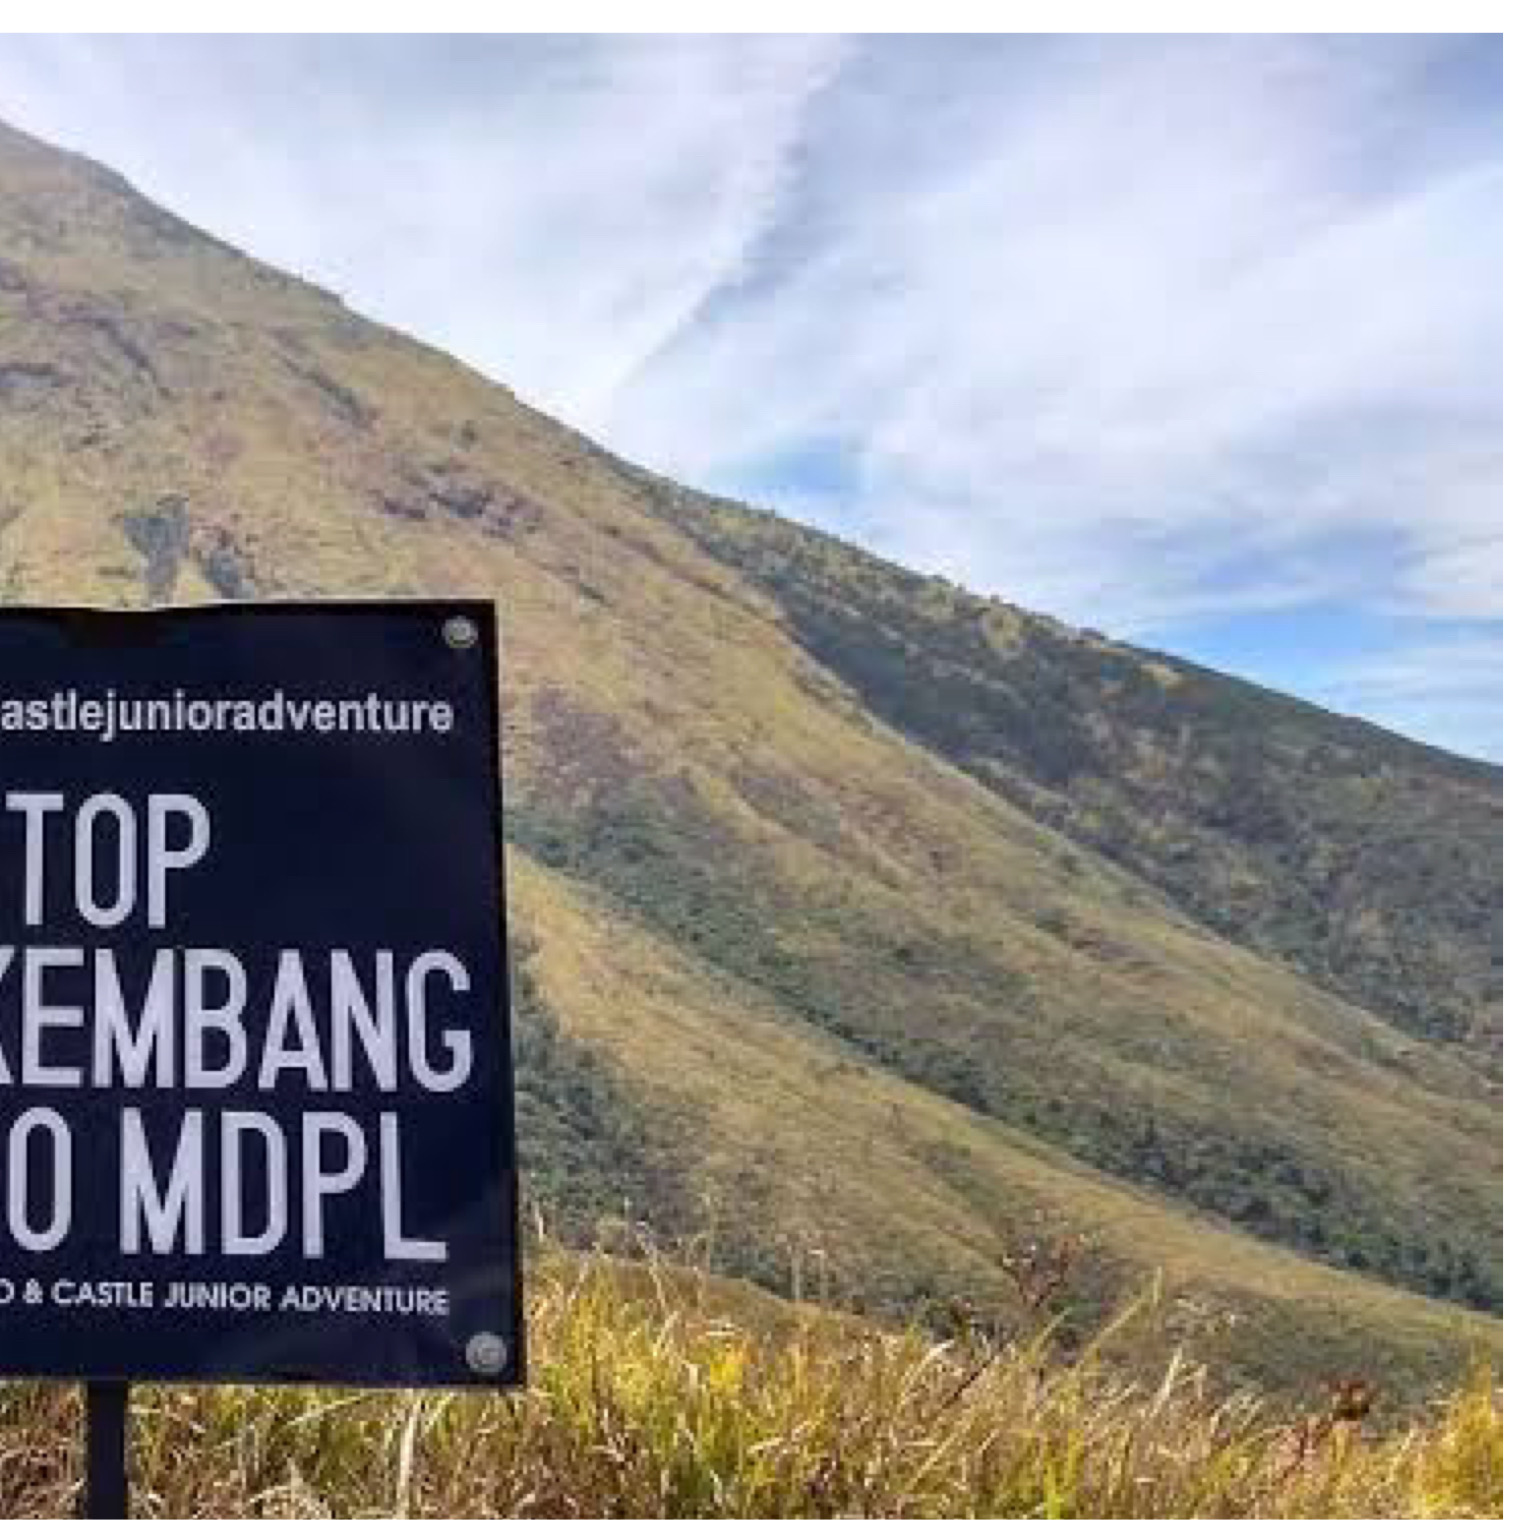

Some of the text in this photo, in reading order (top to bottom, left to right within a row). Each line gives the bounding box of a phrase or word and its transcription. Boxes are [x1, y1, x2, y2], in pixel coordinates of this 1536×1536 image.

[5, 791, 211, 930] TOP
[118, 1106, 449, 1263] MDPL
[22, 1278, 43, 1305] &
[50, 1278, 155, 1309] CASTLE
[163, 1282, 271, 1313] JUNIOR
[278, 1285, 451, 1317] ADVENTURE
